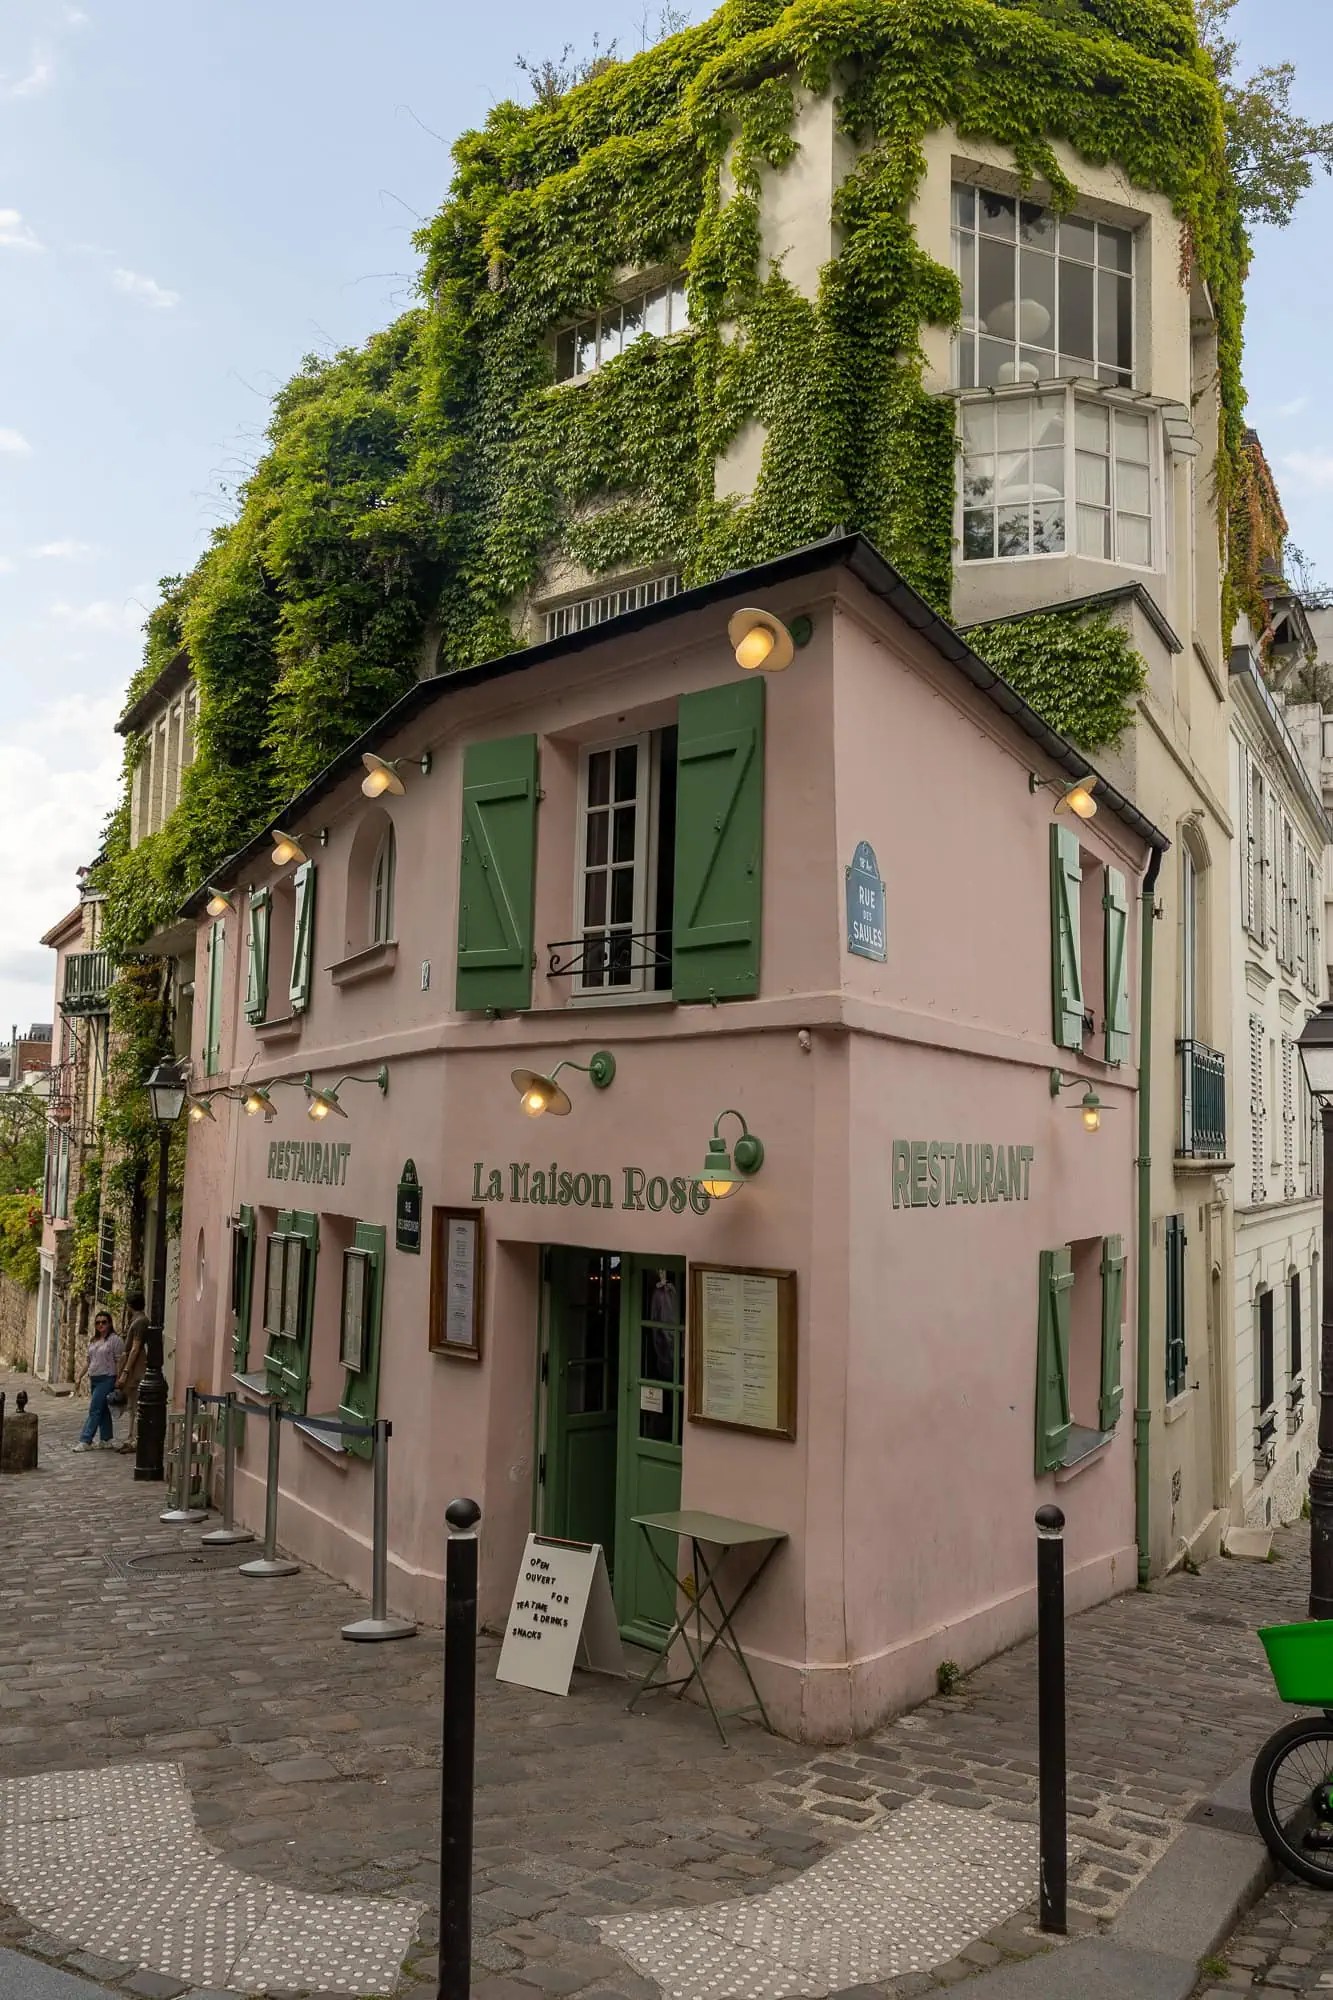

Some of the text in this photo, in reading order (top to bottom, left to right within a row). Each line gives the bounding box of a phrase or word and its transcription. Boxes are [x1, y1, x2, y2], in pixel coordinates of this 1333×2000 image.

[859, 886, 875, 909] RUE
[853, 920, 883, 948] SAULES
[267, 1140, 351, 1186] RESTAURANT
[892, 1139, 1034, 1209] RESTAURANT
[471, 1162, 711, 1216] La Maison Rose
[530, 1558, 550, 1571] OPEN
[525, 1572, 556, 1585] OUVERT
[551, 1592, 569, 1604] FOR
[540, 1615, 568, 1628] DRINKS
[512, 1628, 542, 1641] SNACKS
